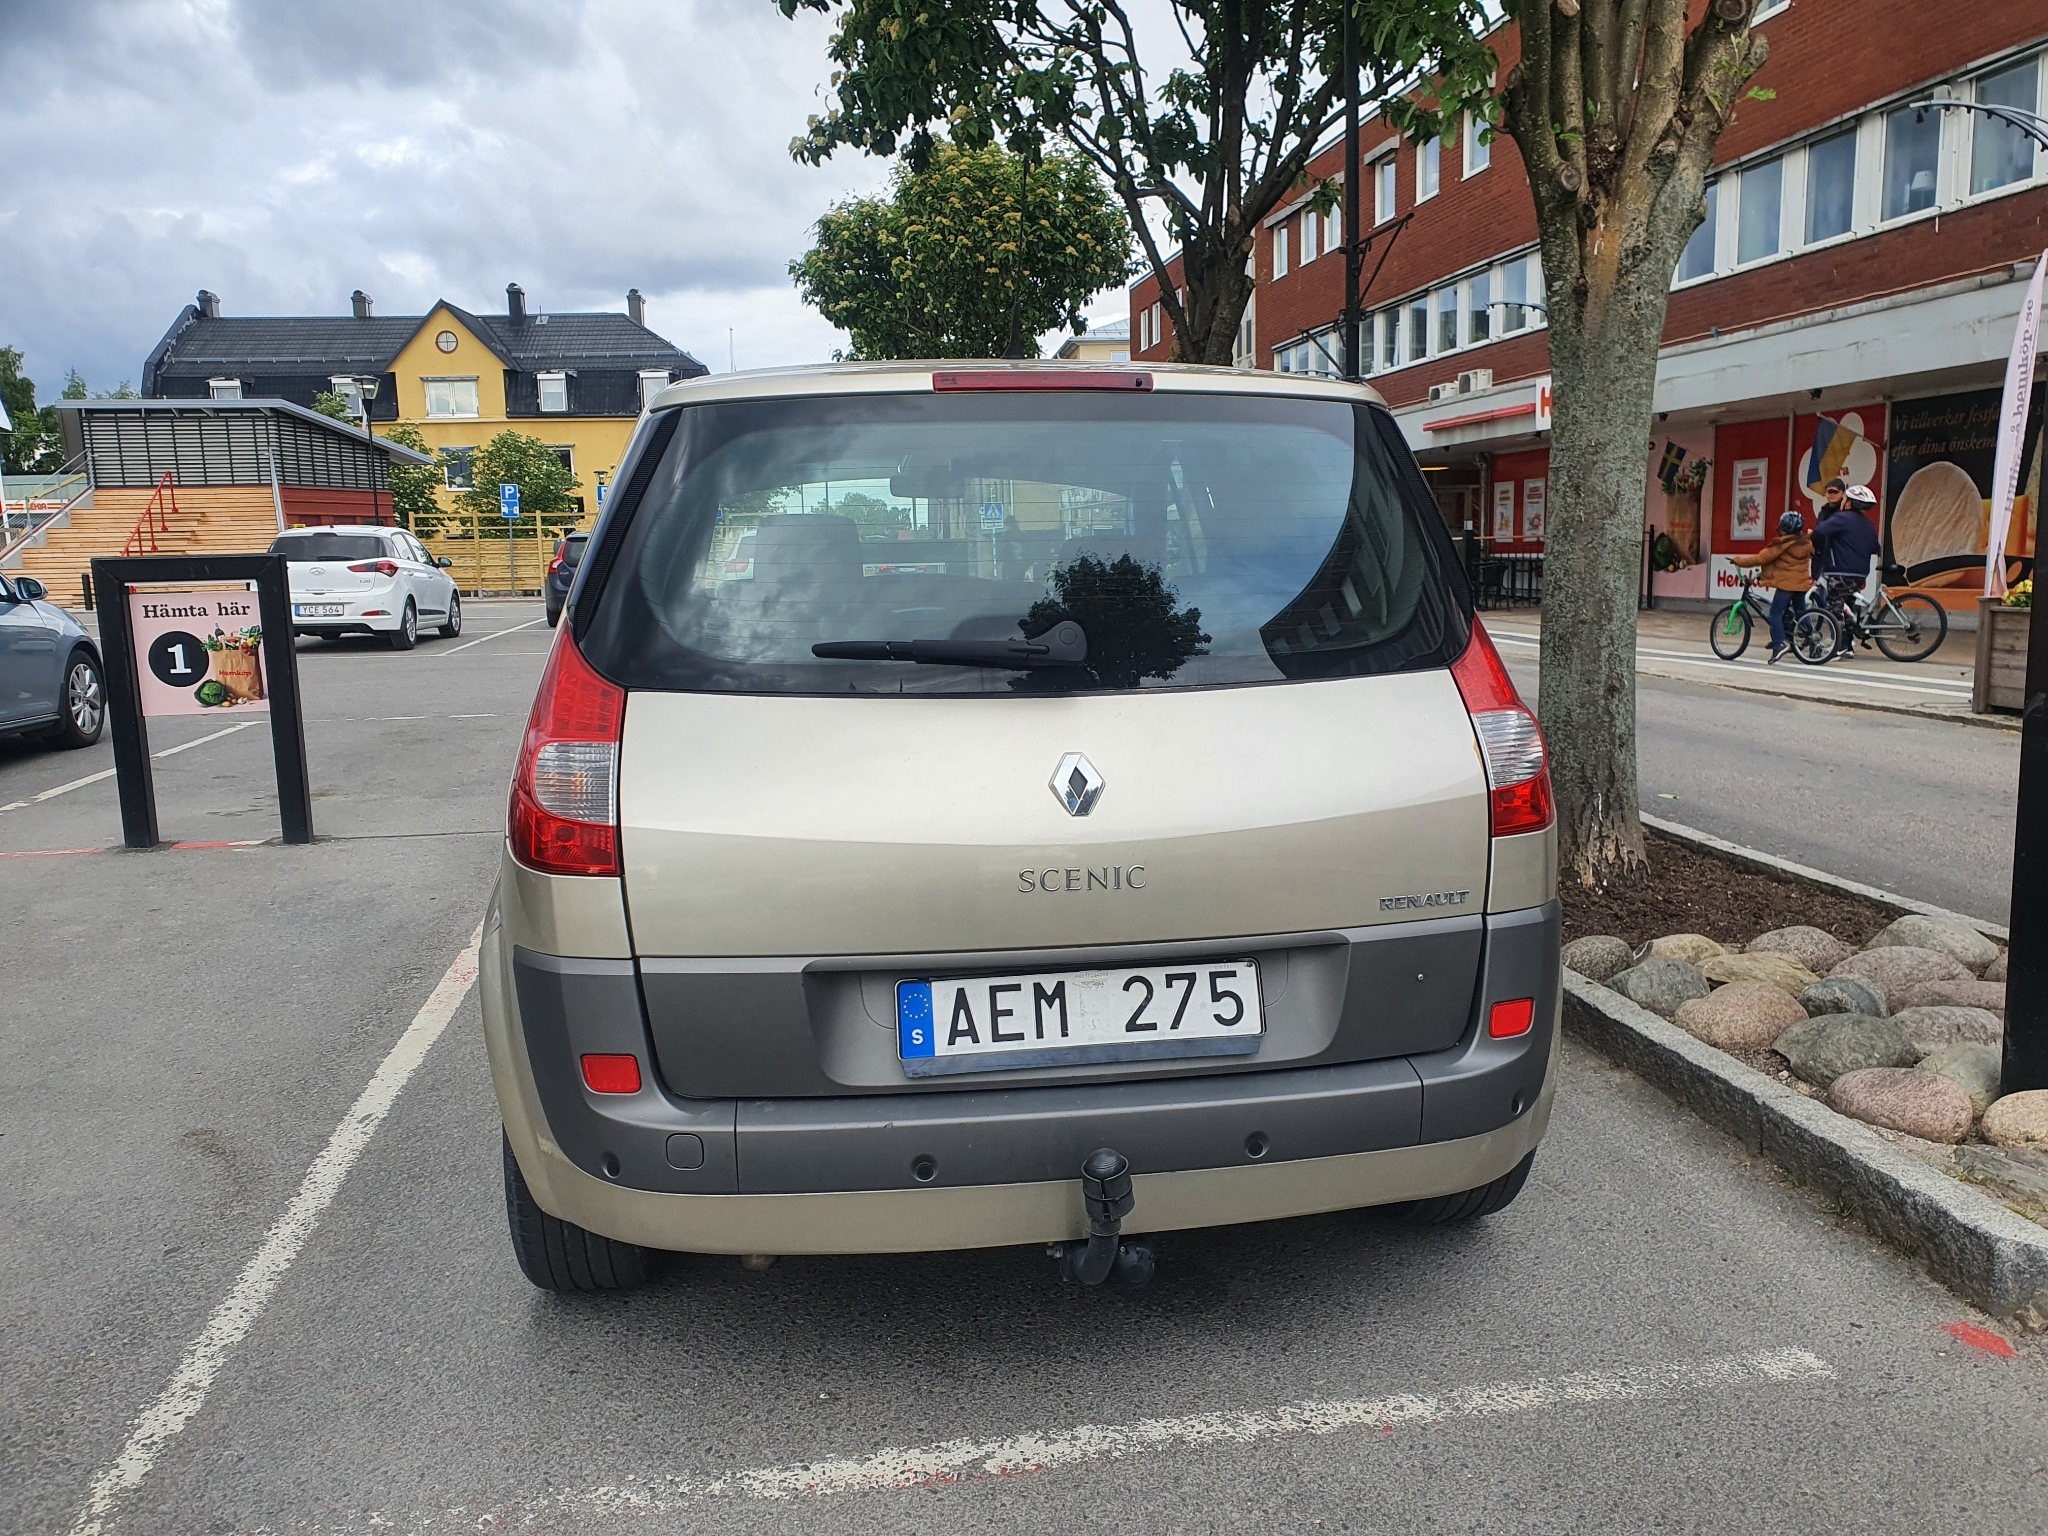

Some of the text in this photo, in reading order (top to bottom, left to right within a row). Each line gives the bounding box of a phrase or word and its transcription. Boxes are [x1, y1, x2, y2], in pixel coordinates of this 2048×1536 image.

[1895, 414, 1908, 431] Vi
[1910, 407, 1966, 430] tillverkar
[1891, 432, 1997, 463] efter dina önskem
[505, 485, 514, 499] P
[142, 601, 251, 619] Hämta här
[302, 605, 340, 614] YCE 564
[167, 643, 192, 674] 1
[218, 669, 252, 677] Hemköp
[1018, 864, 1146, 893] SCENIC
[1379, 889, 1470, 911] RENAULT
[947, 970, 1245, 1046] AEM 275
[911, 1029, 924, 1045] S
